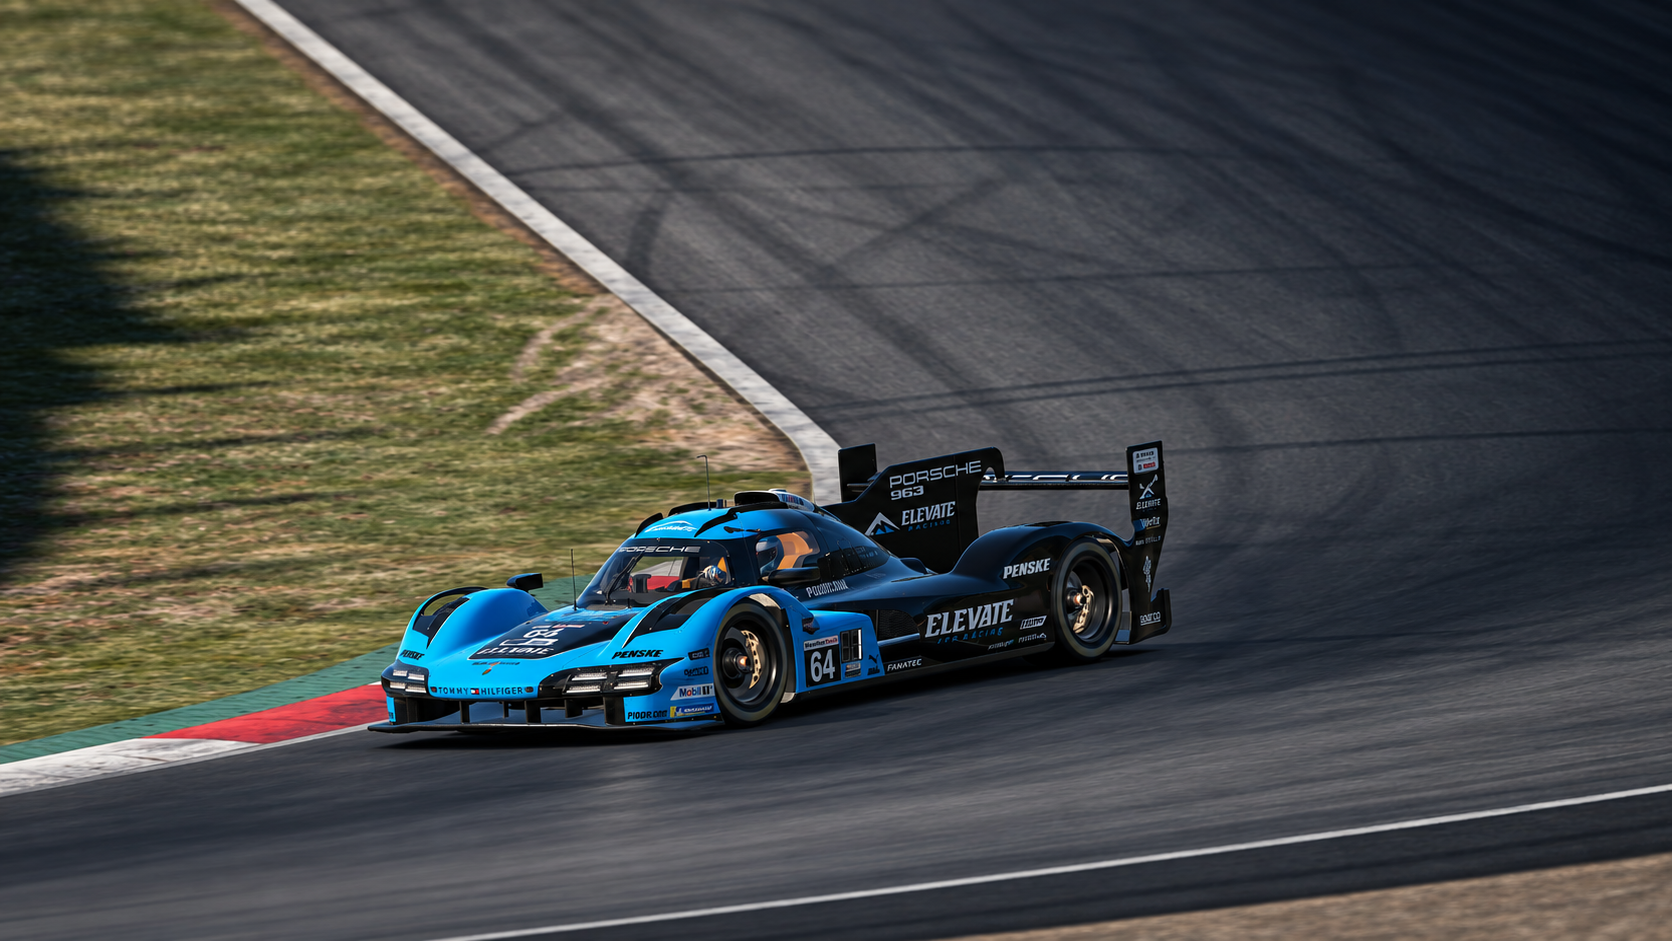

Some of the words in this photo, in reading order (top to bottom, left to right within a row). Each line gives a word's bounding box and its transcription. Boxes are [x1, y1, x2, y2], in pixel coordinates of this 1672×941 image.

[889, 460, 982, 488] PORSCHE
[890, 485, 924, 500] 963
[901, 501, 956, 526] ELEVATE
[1003, 558, 1051, 579] PENSKE
[925, 599, 1015, 638] ELEVATE
[612, 650, 664, 660] PENSKE
[887, 659, 922, 672] FANATEC
[810, 649, 836, 683] 64
[438, 687, 469, 695] TOMMY
[481, 687, 523, 696] HILFIGER
